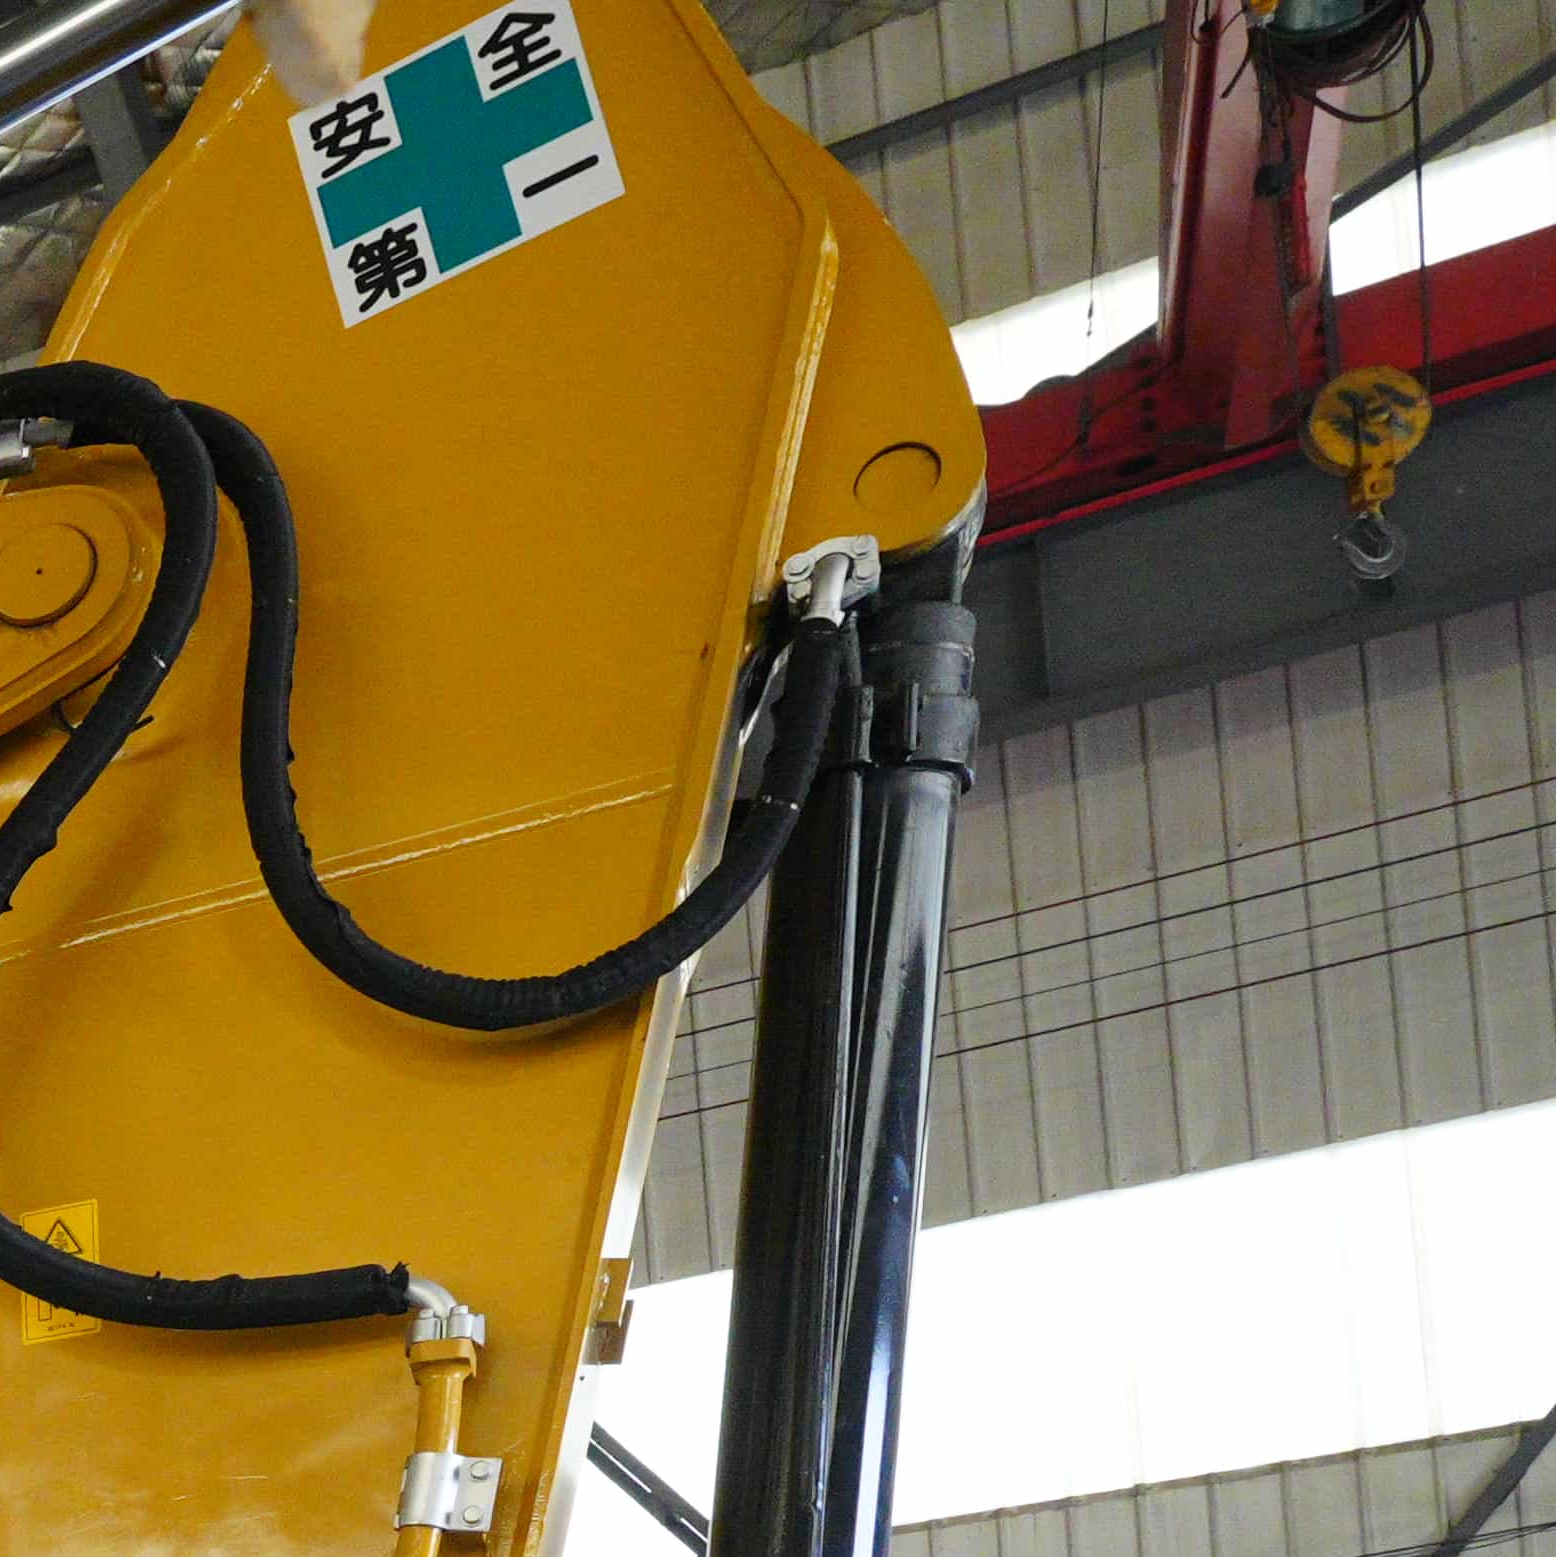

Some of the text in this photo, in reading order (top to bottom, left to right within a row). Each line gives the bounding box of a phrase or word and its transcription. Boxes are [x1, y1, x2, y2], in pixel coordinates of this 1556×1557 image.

[309, 12, 562, 179] 安 全
[347, 222, 427, 313] 第
